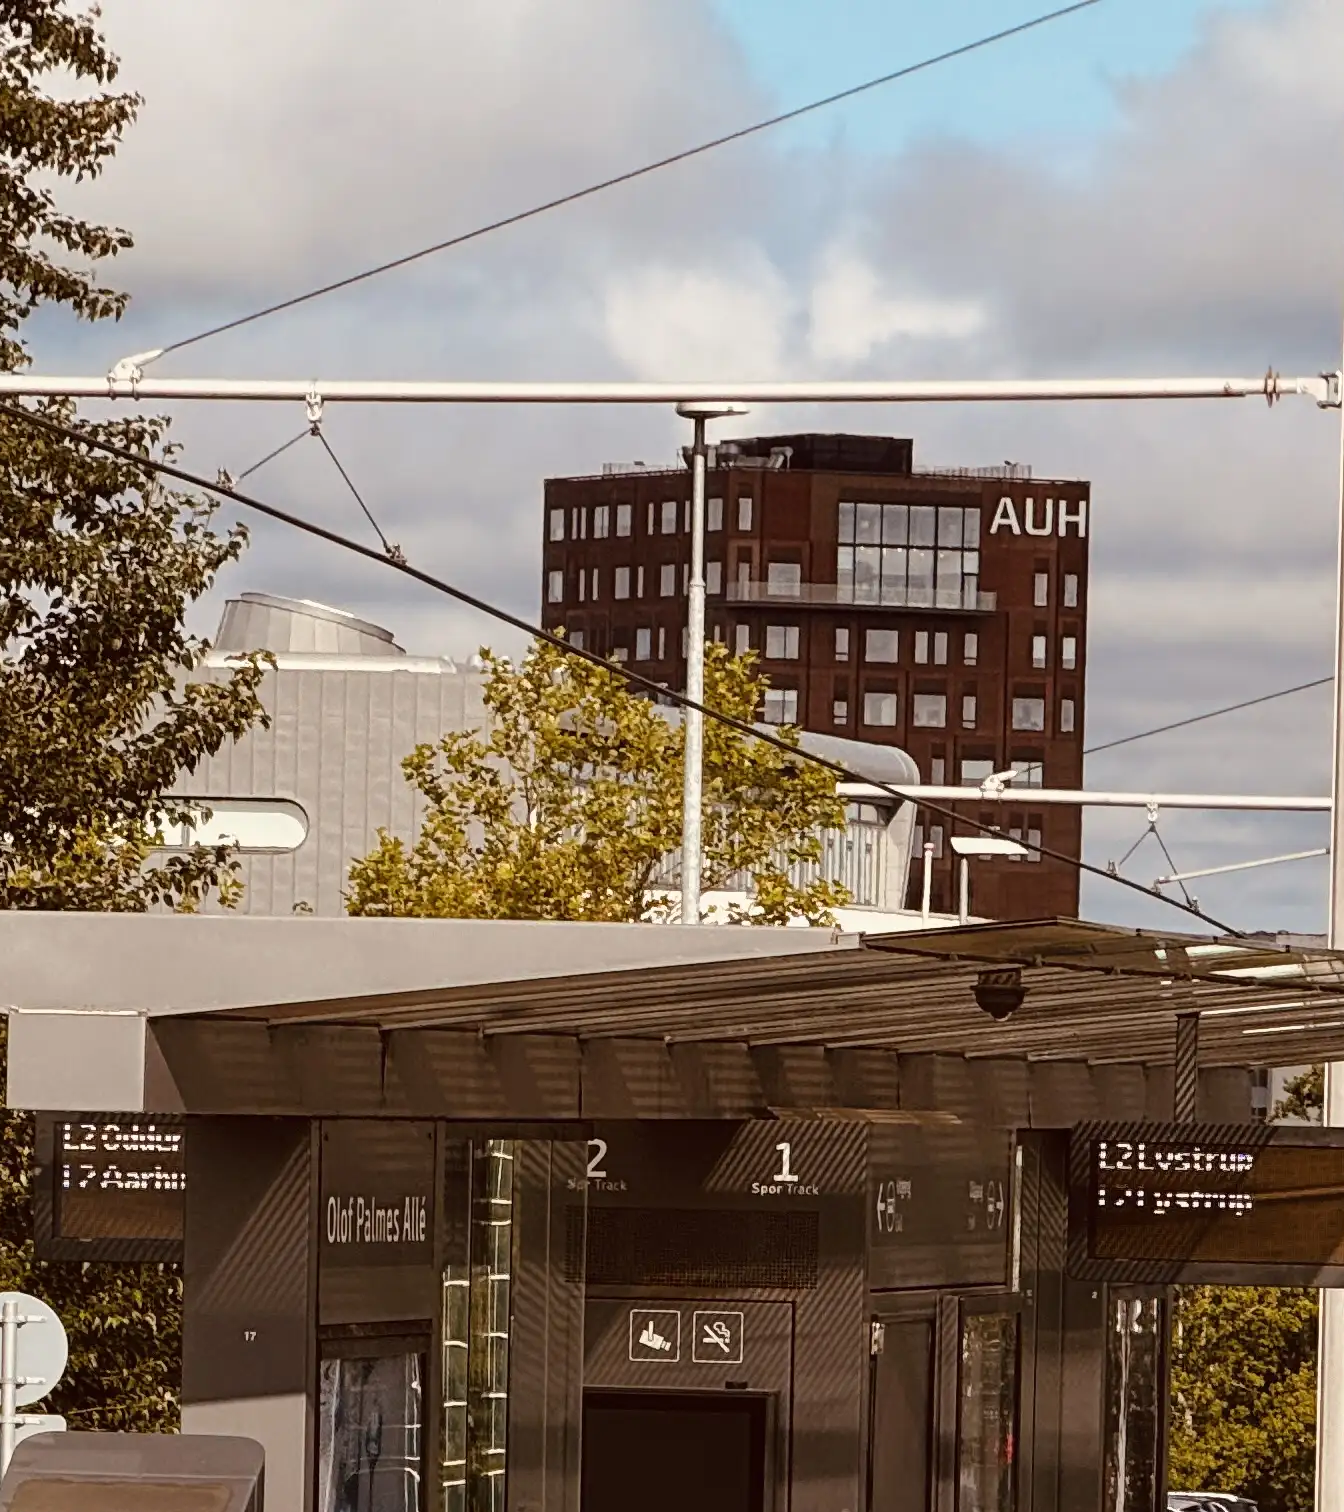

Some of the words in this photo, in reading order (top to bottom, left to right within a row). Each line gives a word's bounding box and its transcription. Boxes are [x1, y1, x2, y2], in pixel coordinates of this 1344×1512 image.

[990, 496, 1087, 538] AUH
[586, 1138, 608, 1178] 2
[773, 1142, 799, 1182] 1
[595, 1178, 628, 1192] Track
[751, 1182, 783, 1195] Spor
[787, 1183, 820, 1196] Track
[327, 1196, 354, 1243] Olof
[356, 1196, 400, 1243] Palmes
[403, 1195, 427, 1242] Allé
